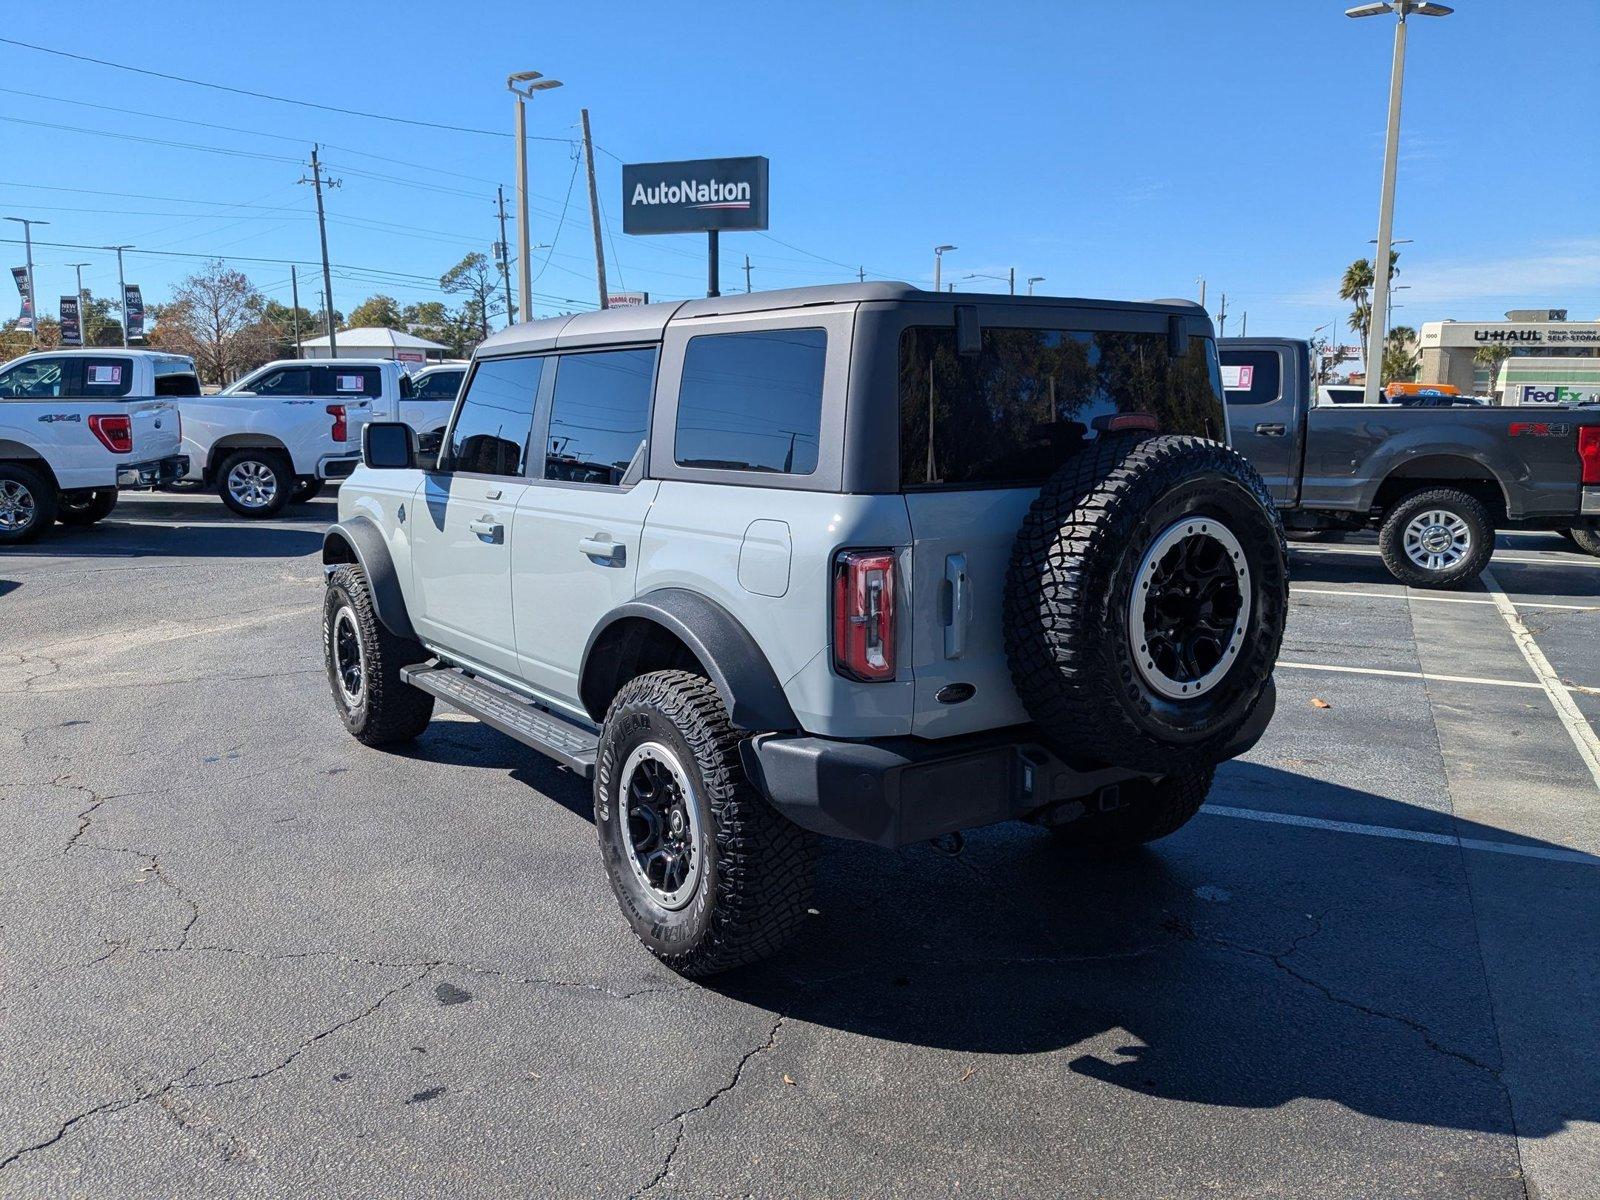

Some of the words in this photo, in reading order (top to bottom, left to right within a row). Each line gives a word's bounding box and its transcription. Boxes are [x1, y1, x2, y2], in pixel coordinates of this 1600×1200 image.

[631, 178, 751, 206] AutoNation
[126, 291, 140, 299] NEW
[1474, 330, 1541, 341] U-HAUL
[1523, 385, 1583, 403] FedEx
[1508, 421, 1570, 437] FX4
